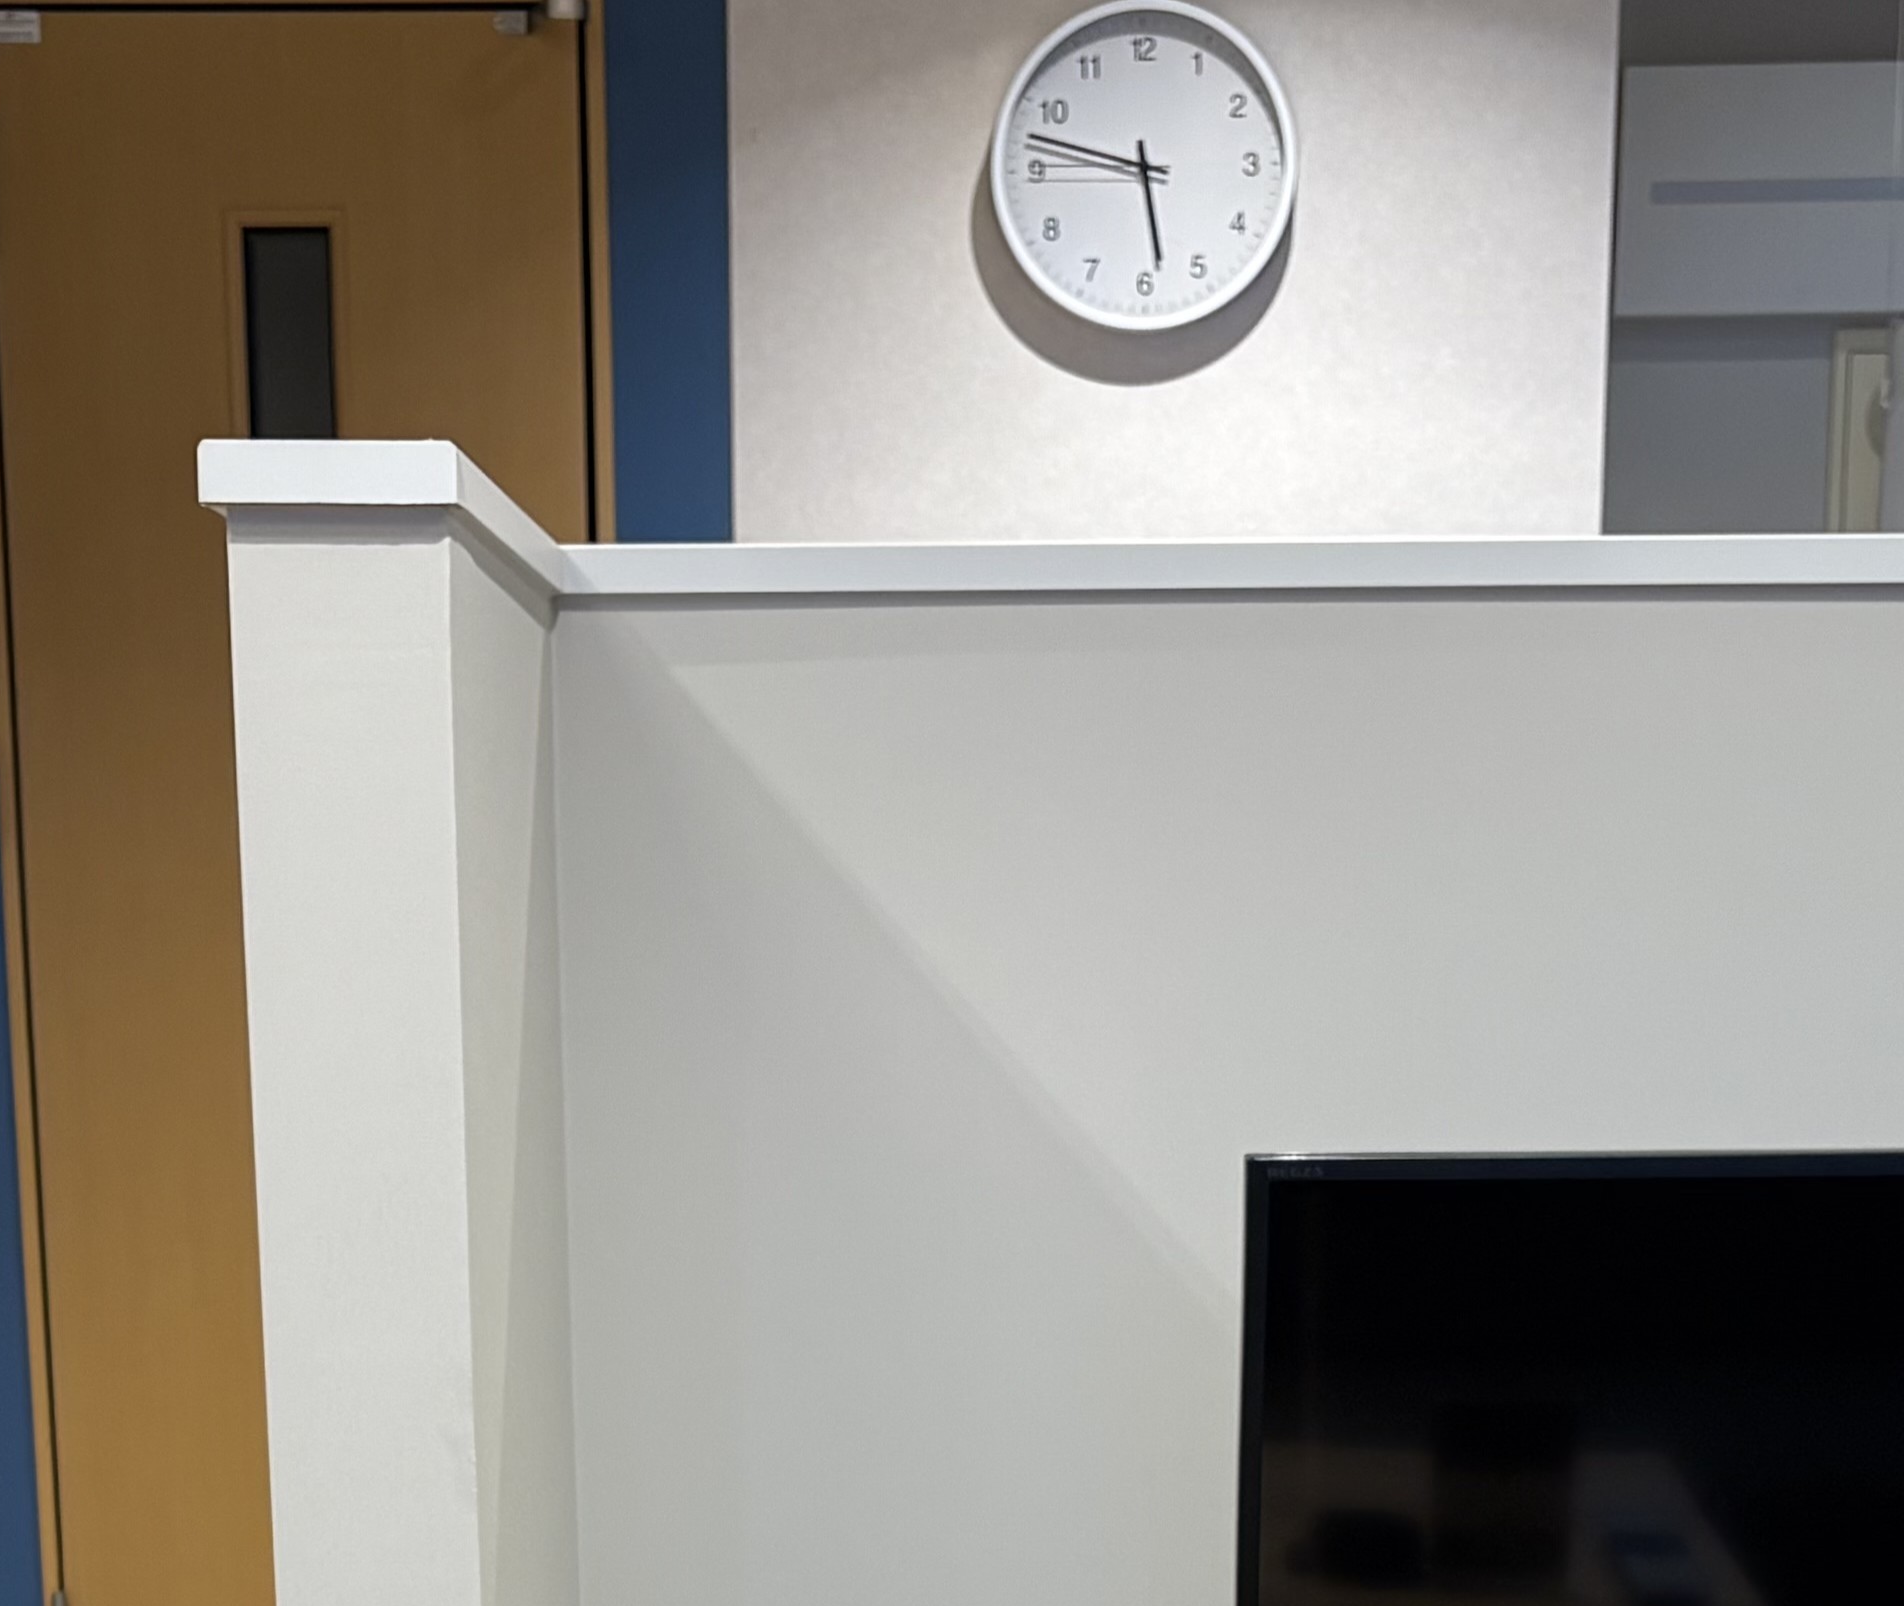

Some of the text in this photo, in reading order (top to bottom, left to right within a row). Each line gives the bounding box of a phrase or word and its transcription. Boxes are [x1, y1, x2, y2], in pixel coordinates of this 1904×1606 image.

[1130, 37, 1157, 61] 12
[1078, 55, 1102, 79] 11
[1191, 52, 1204, 76] 1
[1040, 99, 1069, 124] 10
[1228, 93, 1247, 118] 2
[1027, 159, 1046, 183] 9
[1241, 152, 1260, 176] 3
[1041, 217, 1061, 241] 8
[1228, 211, 1246, 235] 4
[1082, 257, 1100, 282] 7
[1188, 255, 1207, 278] 5
[1136, 271, 1154, 296] 6
